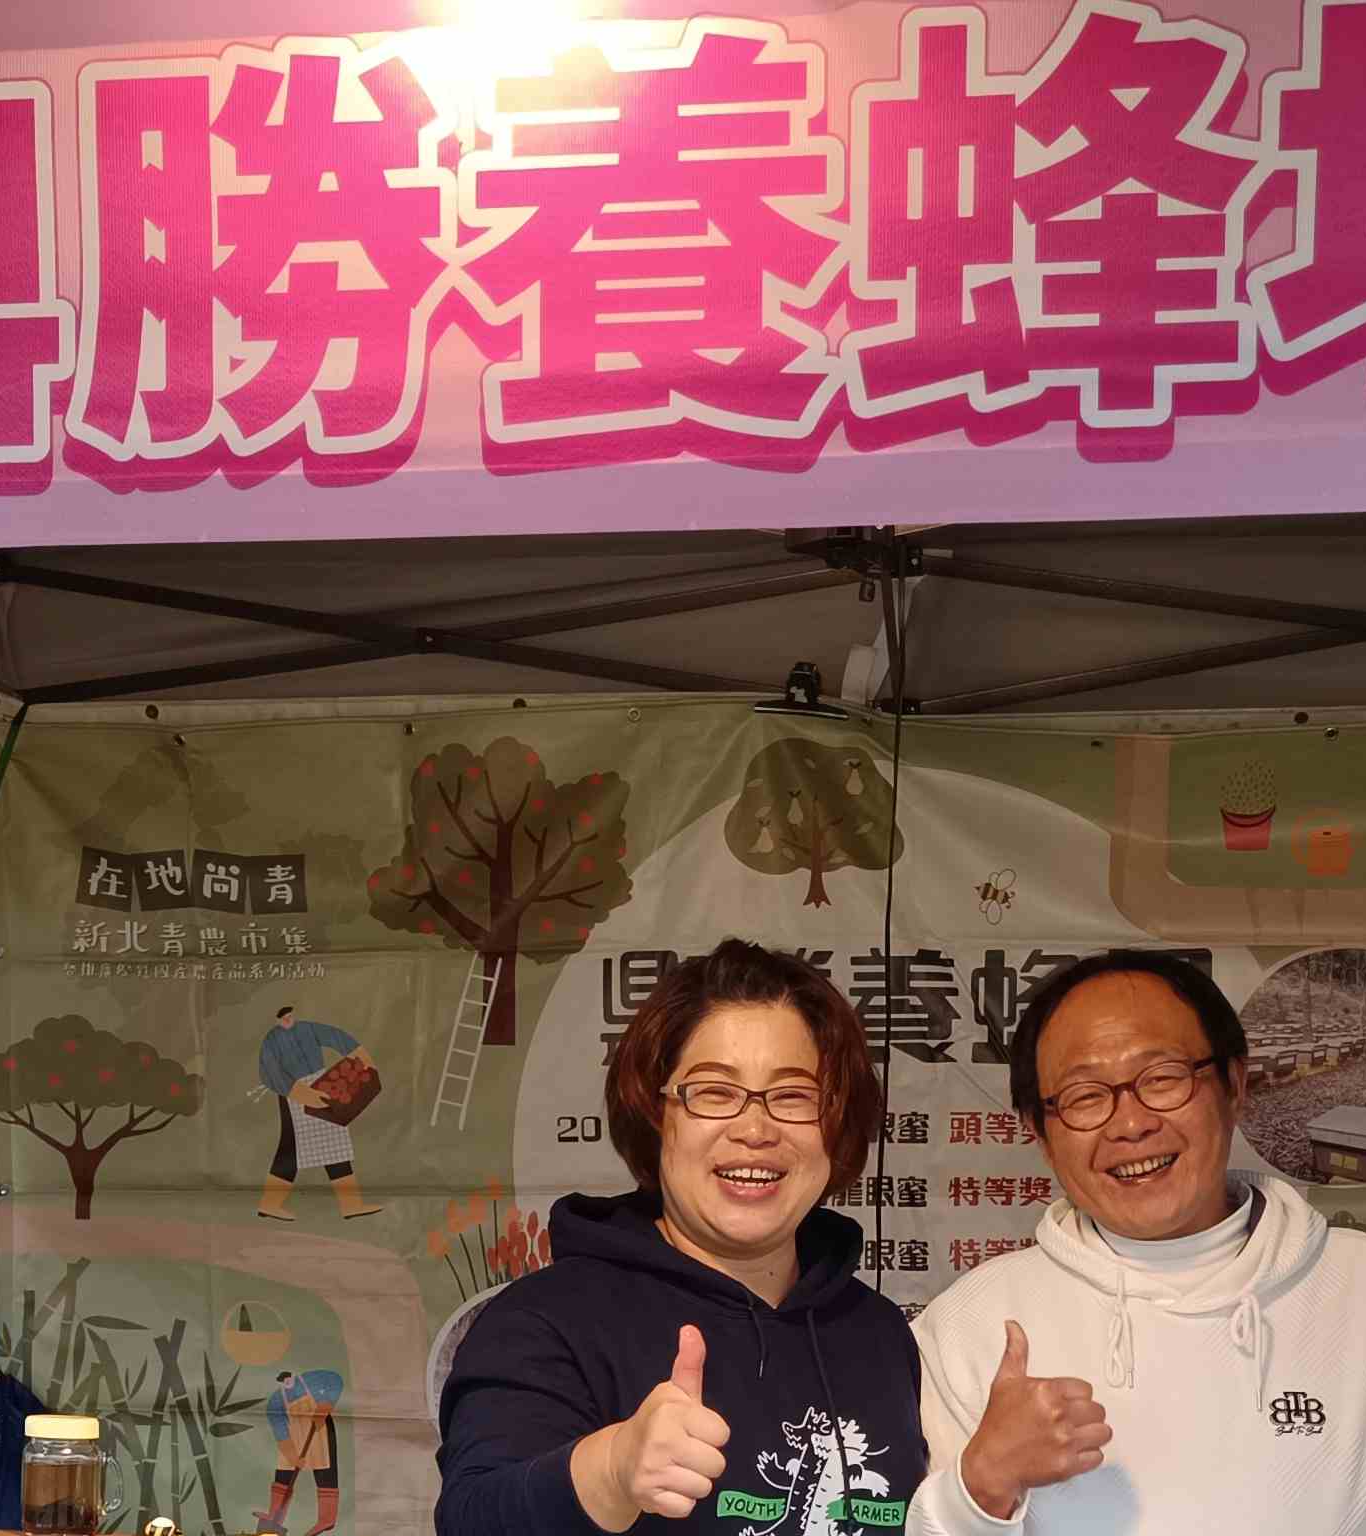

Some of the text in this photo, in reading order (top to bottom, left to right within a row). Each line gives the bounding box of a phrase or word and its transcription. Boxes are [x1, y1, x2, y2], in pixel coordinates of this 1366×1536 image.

[88, 856, 297, 905] 在地尚青
[72, 918, 314, 957] 新北青農市集
[948, 1176, 1053, 1208] 特等獎
[724, 1496, 778, 1517] YOUTH
